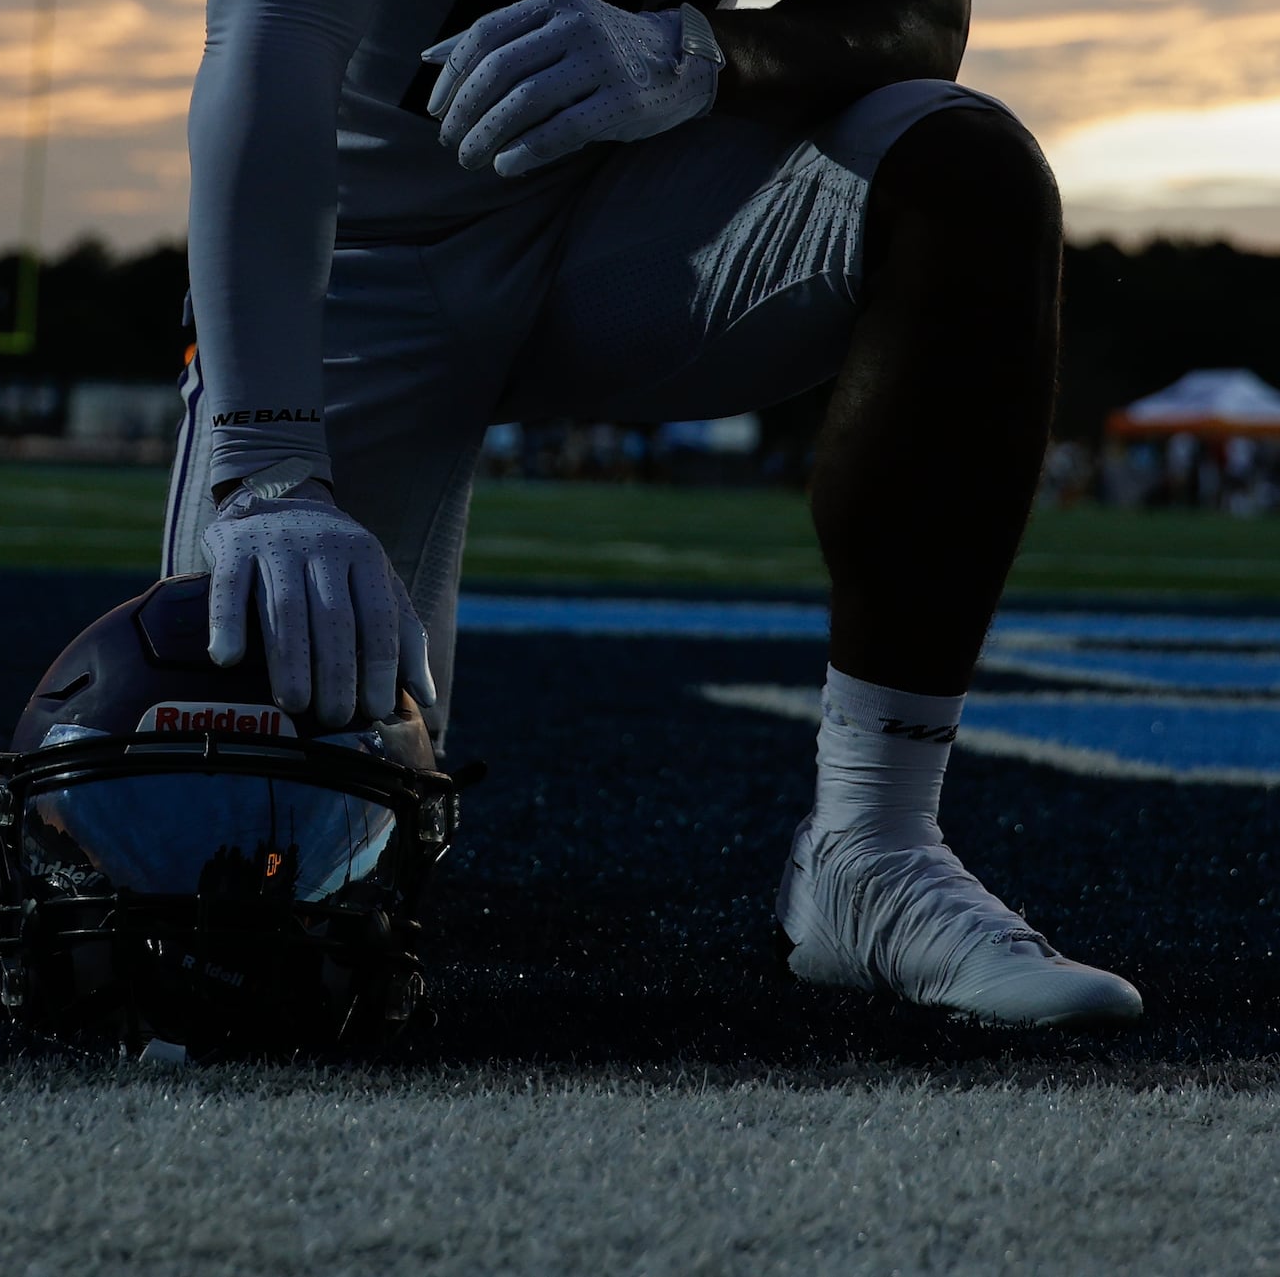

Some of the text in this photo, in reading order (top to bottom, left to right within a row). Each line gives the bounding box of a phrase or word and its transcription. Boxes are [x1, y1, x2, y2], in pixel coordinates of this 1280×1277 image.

[212, 408, 321, 427] WE BALL
[155, 707, 281, 736] Riddell
